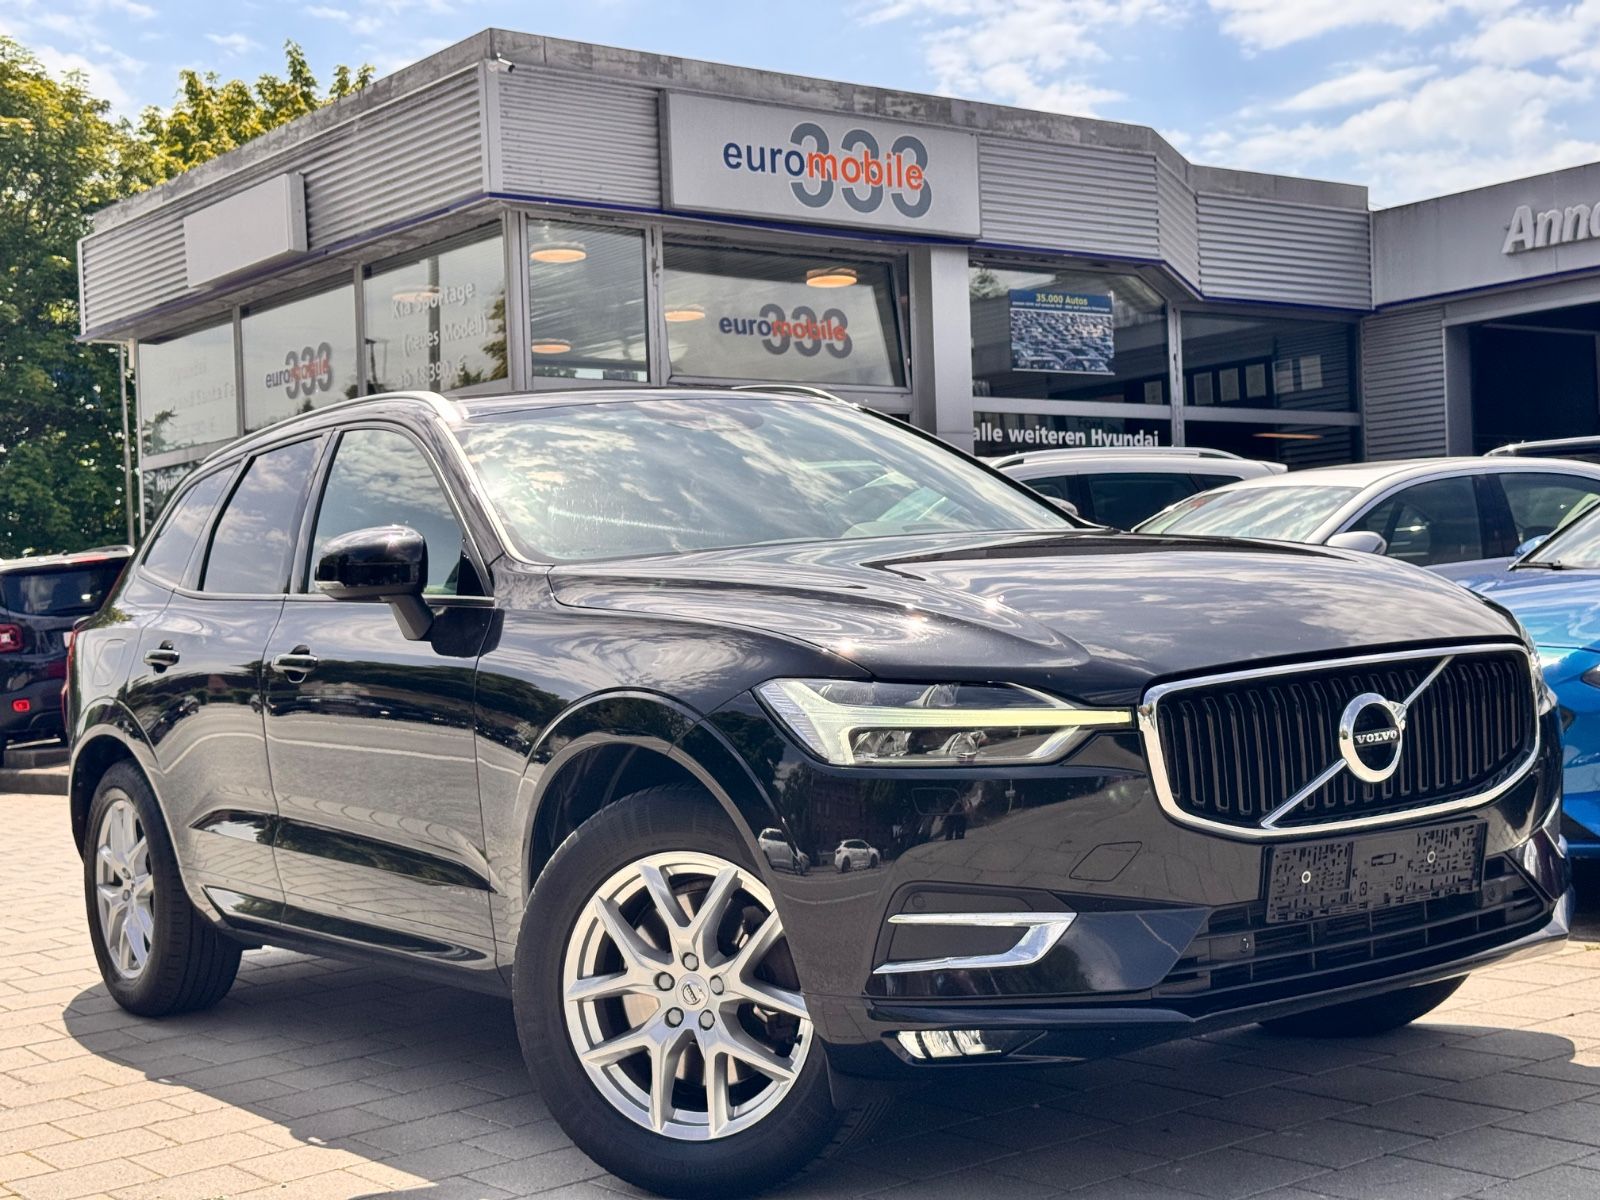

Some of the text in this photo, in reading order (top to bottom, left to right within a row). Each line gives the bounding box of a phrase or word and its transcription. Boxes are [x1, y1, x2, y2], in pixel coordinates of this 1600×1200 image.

[723, 142, 924, 190] euromobile
[1035, 293, 1088, 305] 35.000 Autos
[719, 316, 847, 341] euromobile
[758, 303, 852, 359] 333
[1008, 425, 1086, 446] weiteren
[1091, 429, 1159, 447] Hyundai
[1355, 730, 1397, 743] VOLVO
